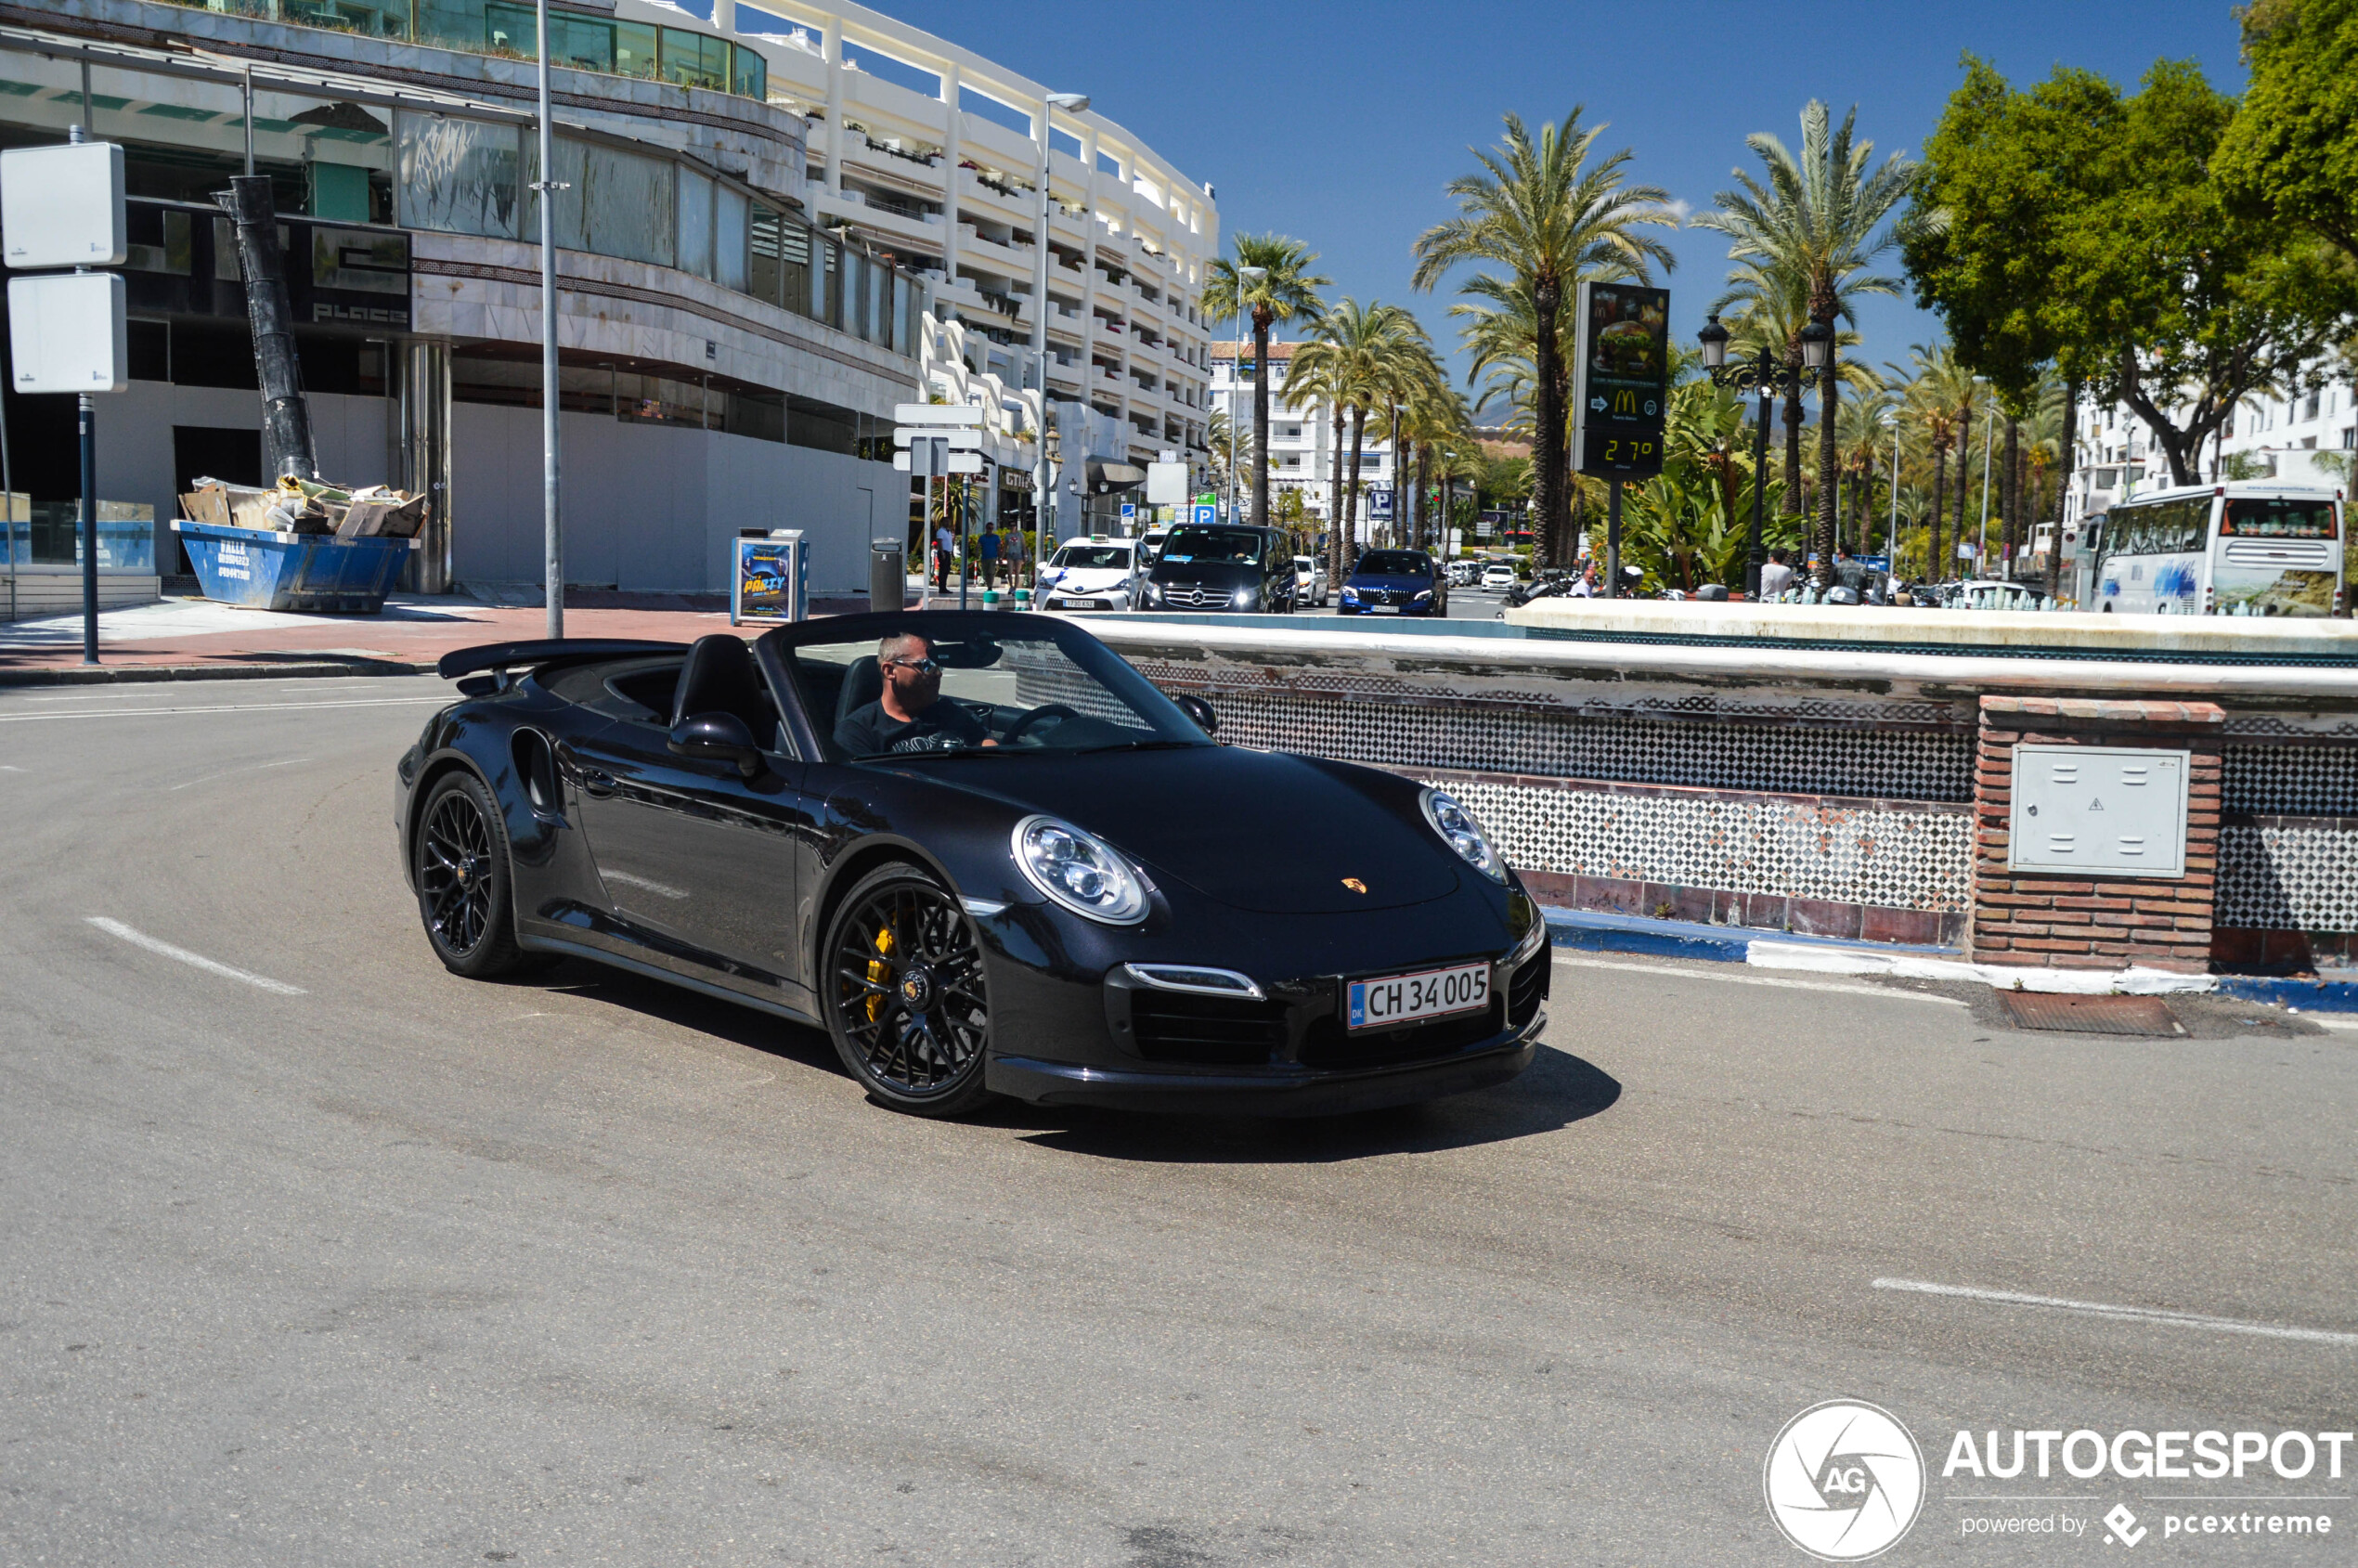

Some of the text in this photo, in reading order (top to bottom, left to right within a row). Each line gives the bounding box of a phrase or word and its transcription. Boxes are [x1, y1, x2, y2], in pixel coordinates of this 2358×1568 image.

[1160, 452, 1176, 462] TAXI
[1199, 510, 1211, 524] P
[744, 576, 786, 593] PARTY
[1369, 969, 1487, 1017] CH 34 005
[1352, 1008, 1363, 1019] DK
